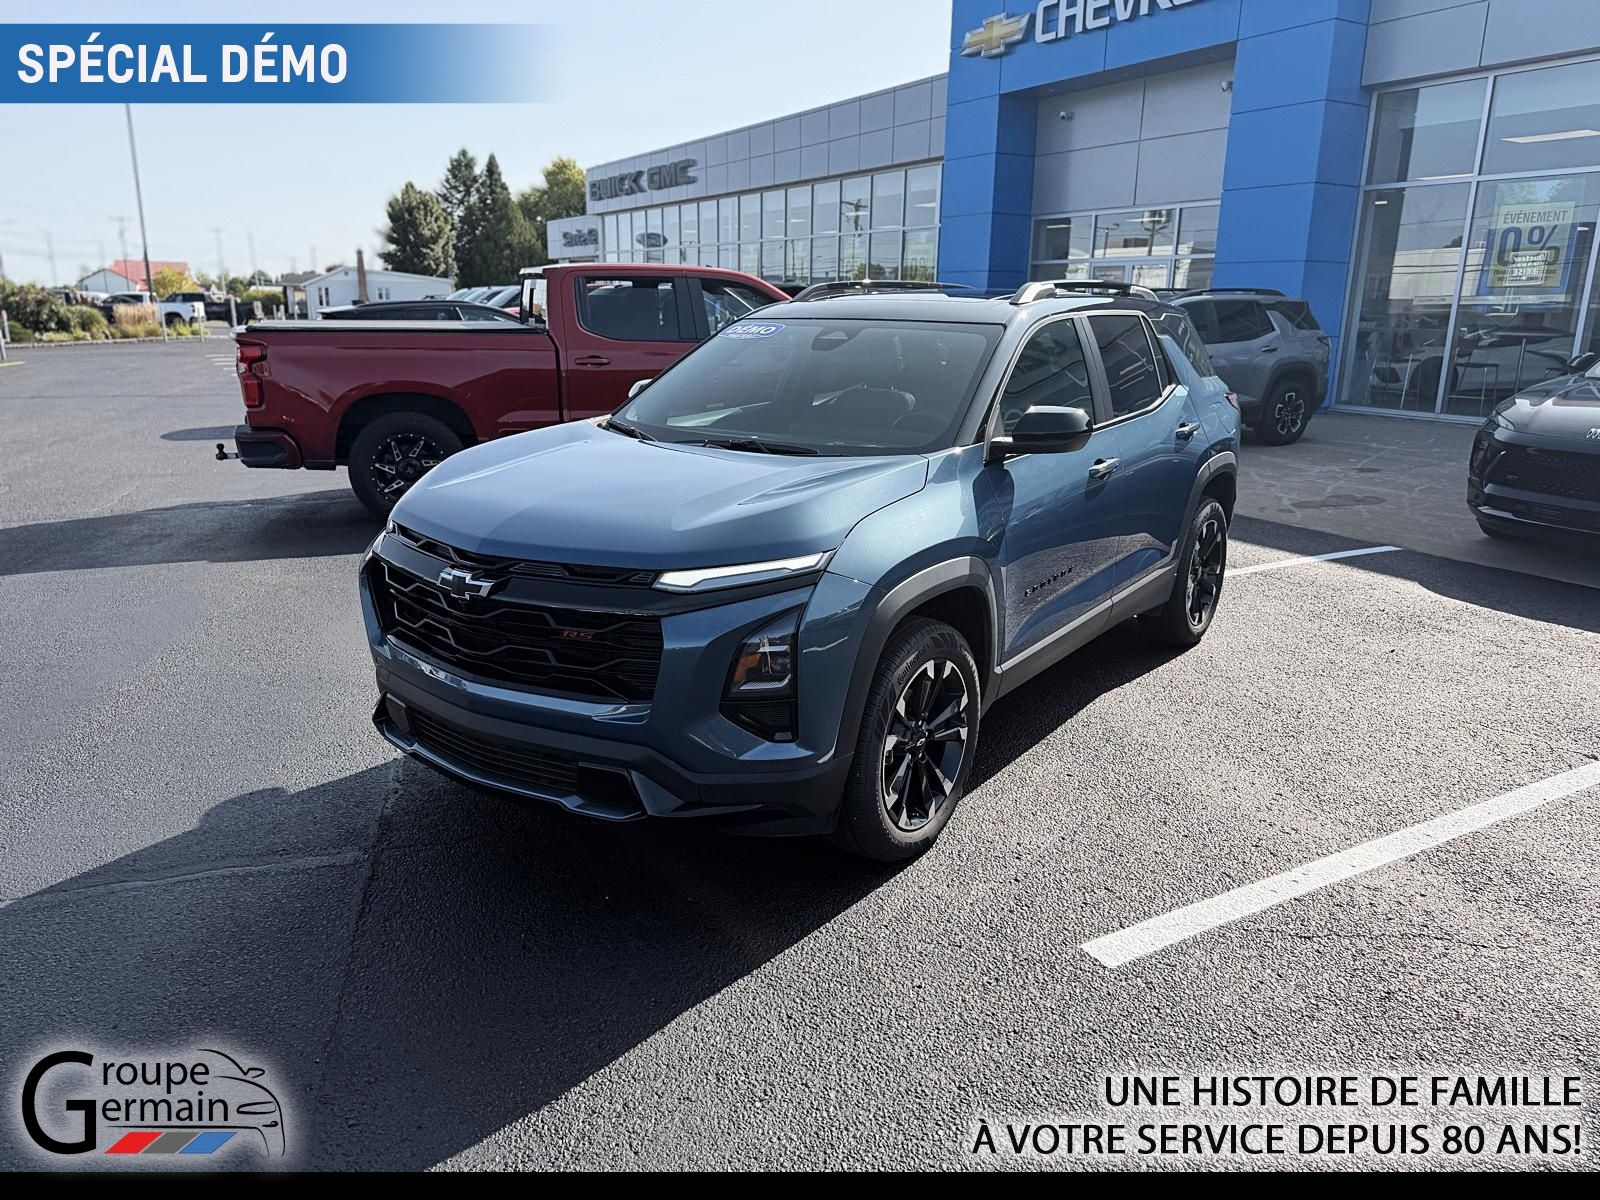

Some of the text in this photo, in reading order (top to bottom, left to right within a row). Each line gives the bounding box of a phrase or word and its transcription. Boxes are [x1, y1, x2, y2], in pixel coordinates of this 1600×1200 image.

[590, 159, 698, 201] BUICK GMC
[1503, 210, 1569, 225] ÉVÉNEMENT
[560, 630, 593, 640] RS
